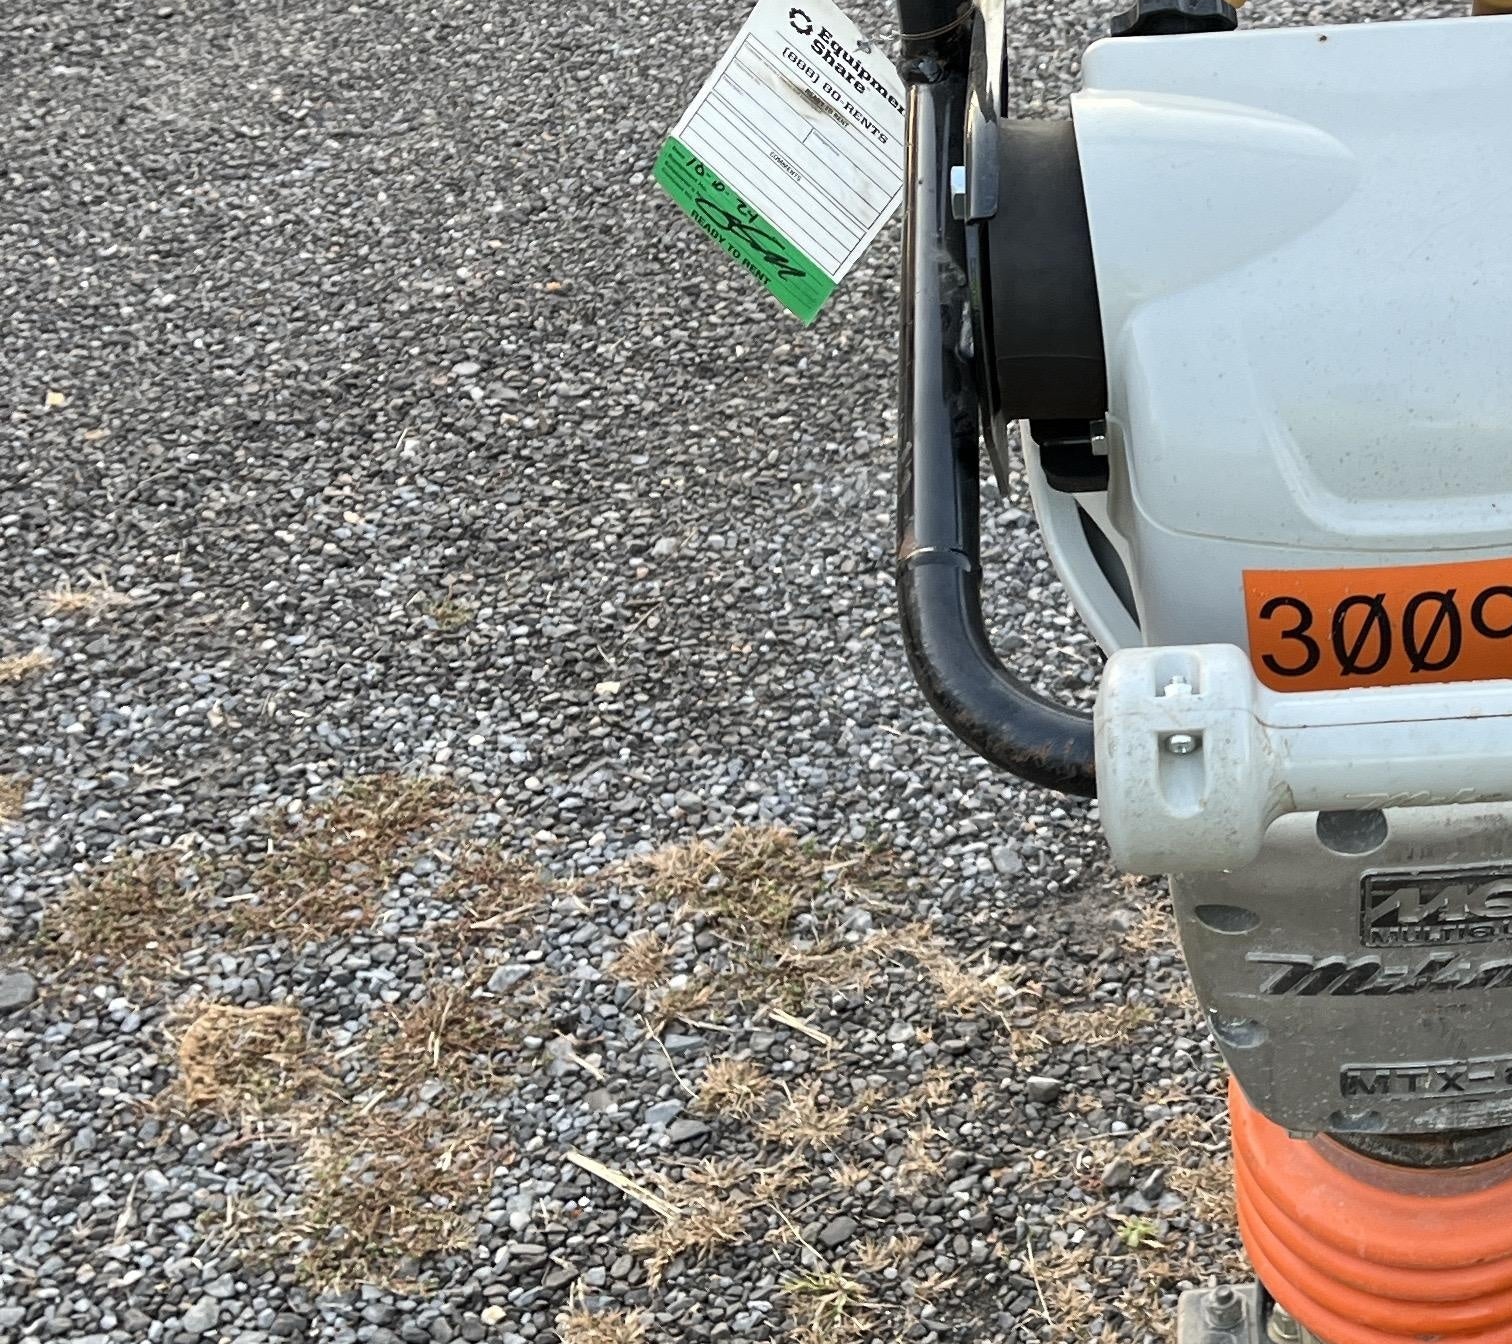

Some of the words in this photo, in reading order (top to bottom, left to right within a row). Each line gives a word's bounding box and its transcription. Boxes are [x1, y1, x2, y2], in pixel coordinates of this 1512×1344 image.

[782, 47, 820, 84] (888)
[822, 82, 889, 144] 80-RENTS
[811, 38, 866, 94] Share
[691, 209, 726, 244] READY
[727, 243, 741, 259] TO
[742, 258, 772, 285] RENT
